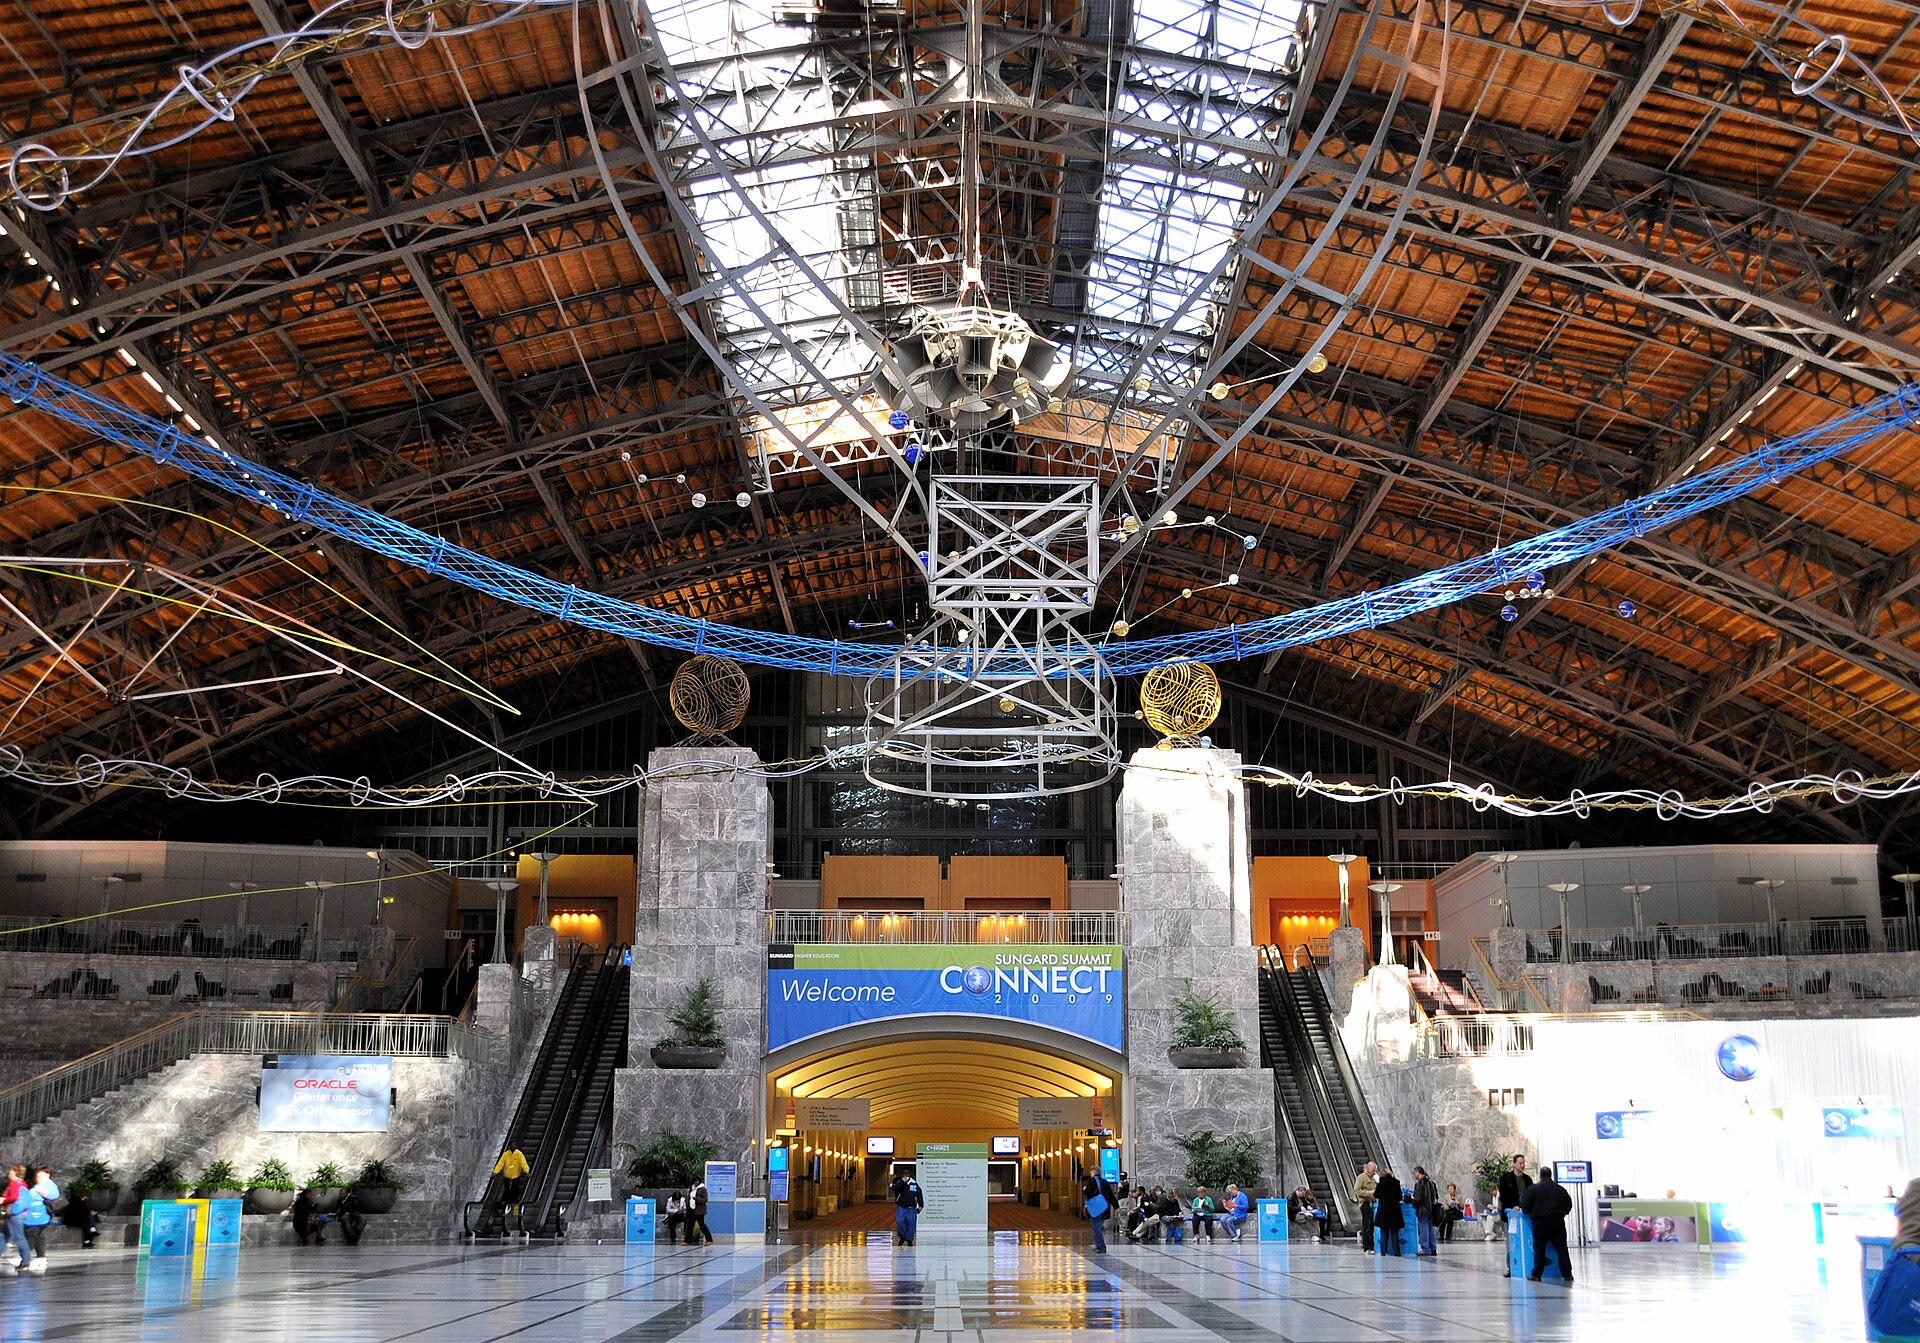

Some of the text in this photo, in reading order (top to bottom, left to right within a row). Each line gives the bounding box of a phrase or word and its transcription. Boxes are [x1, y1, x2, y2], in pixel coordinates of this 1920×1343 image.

[995, 953, 1112, 966] SUNGARD SUMMIT
[940, 965, 1112, 995] CONNECT
[781, 978, 896, 1003] Welcome
[294, 1079, 358, 1089] ORACLE
[293, 1091, 359, 1102] Conference
